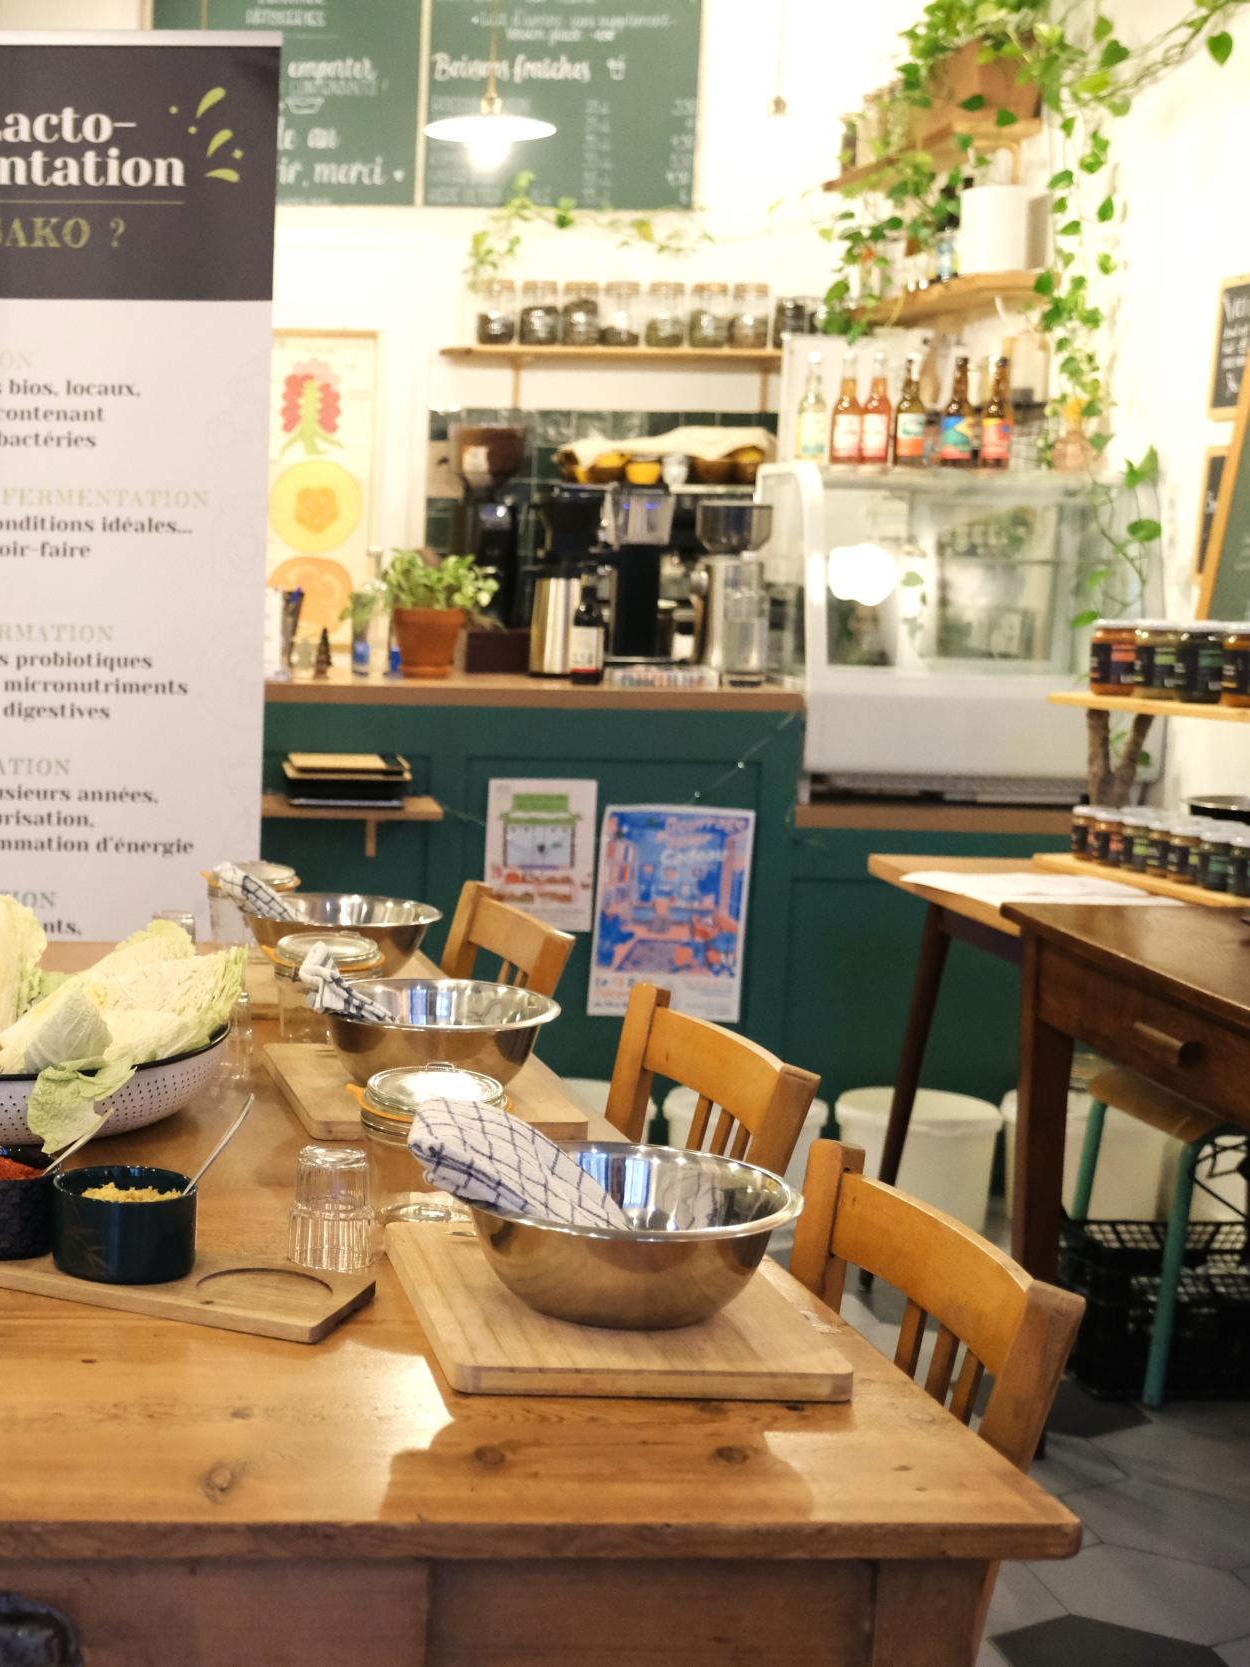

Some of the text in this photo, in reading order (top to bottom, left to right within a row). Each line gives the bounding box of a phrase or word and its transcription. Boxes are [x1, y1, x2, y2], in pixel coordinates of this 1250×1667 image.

[313, 156, 388, 186] merci
[109, 218, 126, 248] ?
[9, 378, 60, 398] bios,
[65, 379, 142, 399] locaux,
[2, 486, 209, 509] FERMENTATION
[15, 651, 154, 673] probiotiques
[3, 677, 190, 697] micronutriments
[3, 702, 112, 722] digestives
[77, 786, 160, 806] années,
[95, 836, 195, 858] d'énergie
